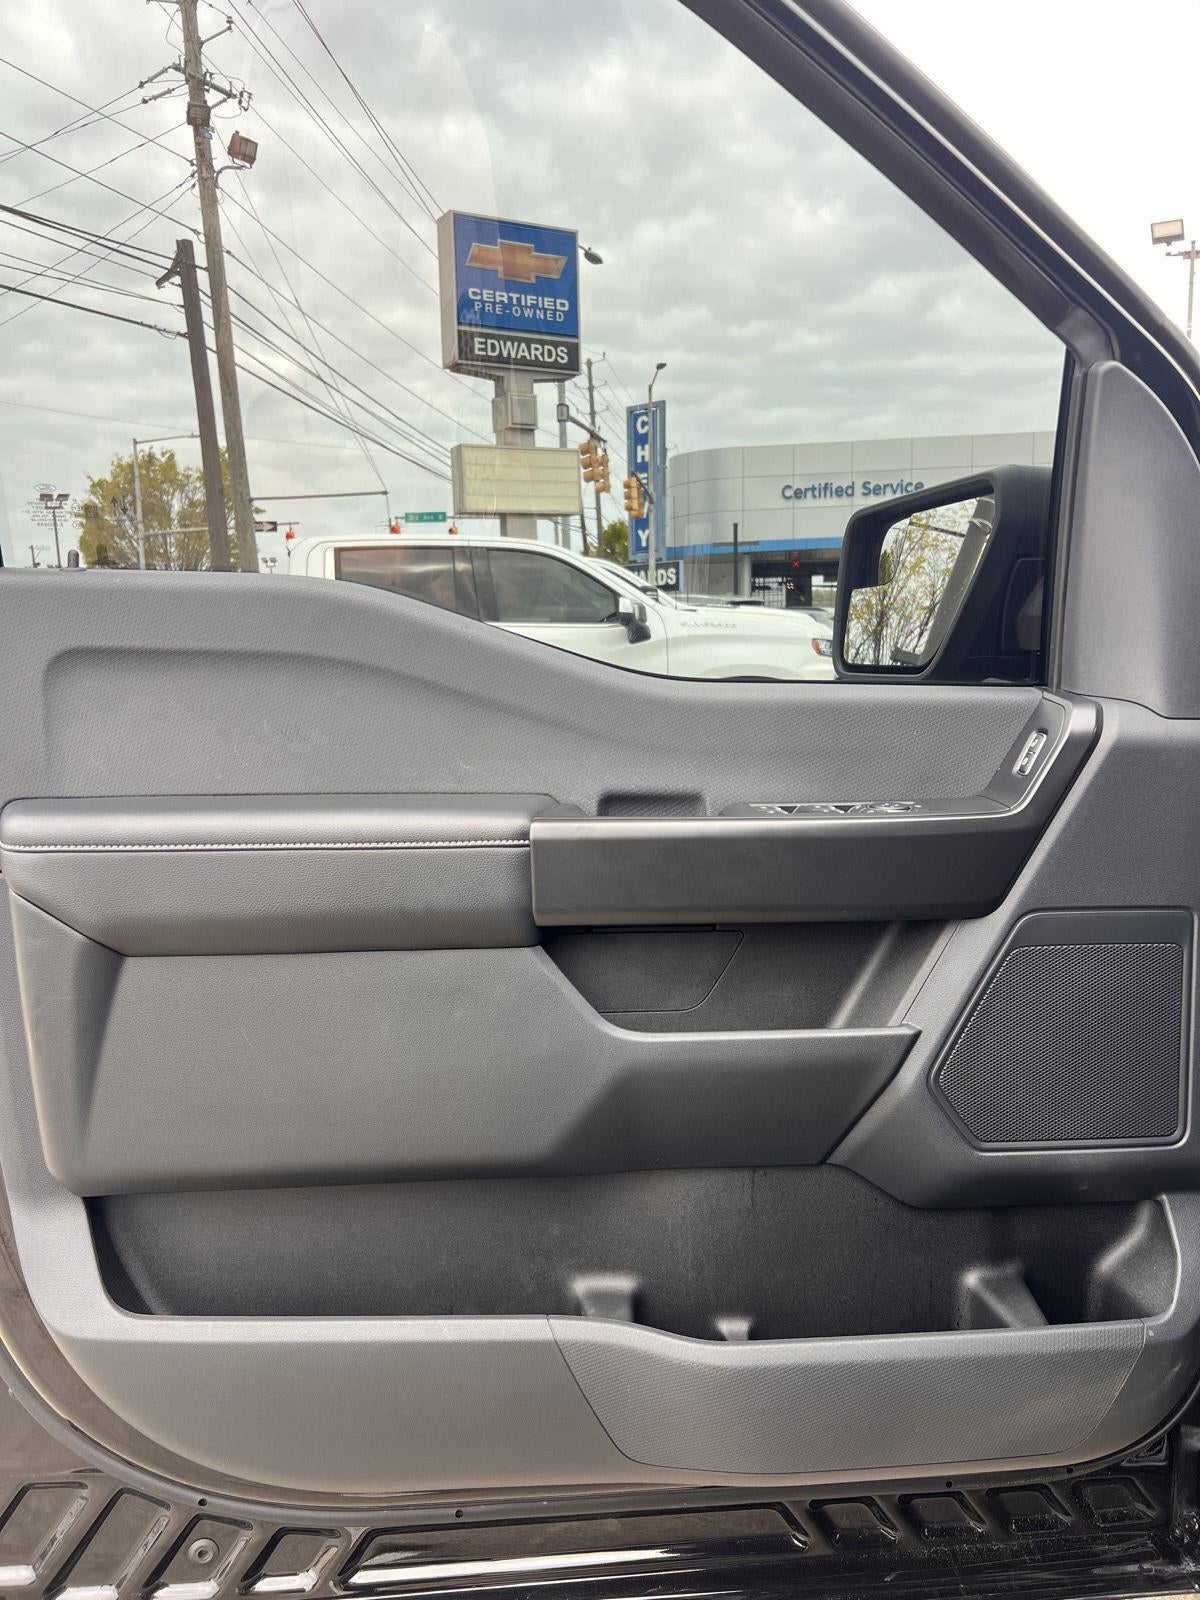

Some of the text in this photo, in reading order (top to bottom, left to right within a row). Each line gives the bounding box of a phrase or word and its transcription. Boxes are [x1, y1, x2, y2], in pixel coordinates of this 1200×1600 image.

[468, 287, 569, 312] CERTIFIED
[474, 301, 564, 322] PRE-OWNED
[474, 337, 569, 364] EDWARDS
[781, 478, 925, 500] Certified Service
